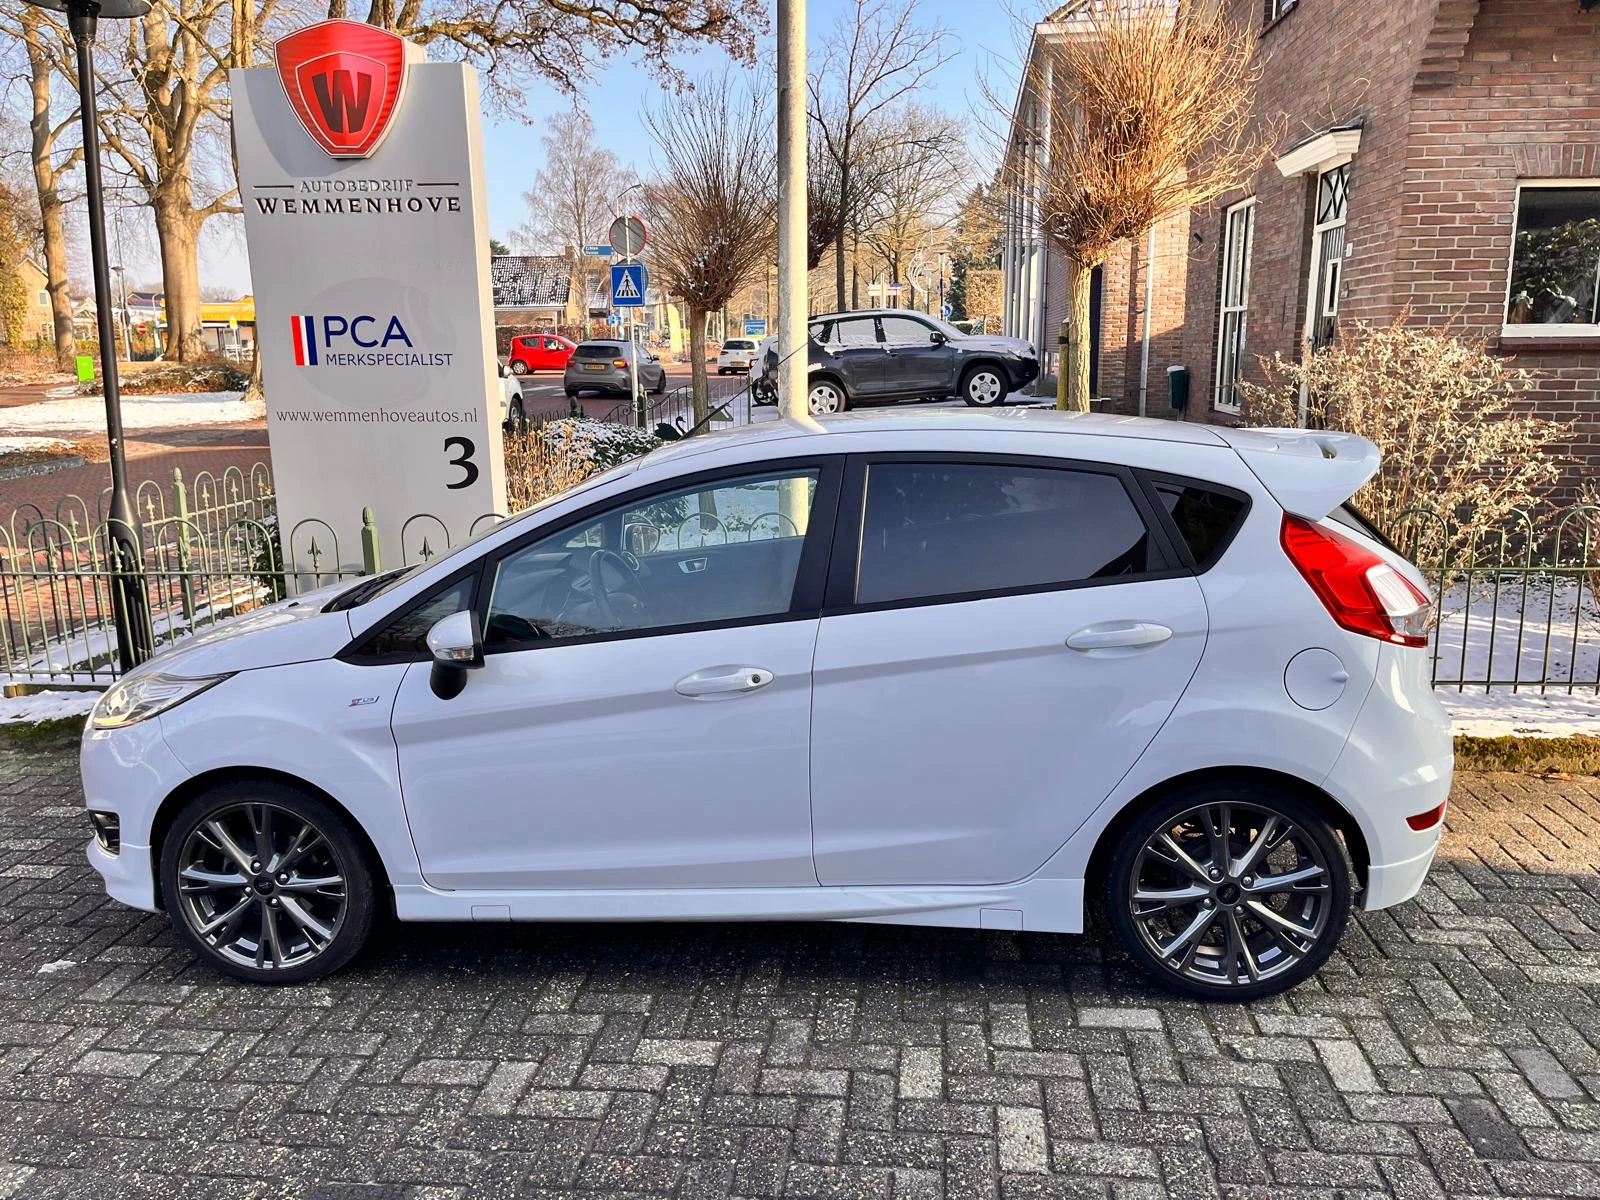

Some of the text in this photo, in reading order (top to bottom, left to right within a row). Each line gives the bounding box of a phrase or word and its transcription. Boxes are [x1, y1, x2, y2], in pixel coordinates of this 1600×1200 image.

[312, 69, 373, 133] W
[300, 179, 413, 193] AUTOBEDRIJF
[255, 197, 461, 214] WEMMENHOVE
[323, 315, 413, 348] PCA
[326, 353, 453, 366] MERKSPECIALIST
[276, 407, 478, 424] www.wemmenhoveautos.nl
[443, 436, 479, 490] 3
